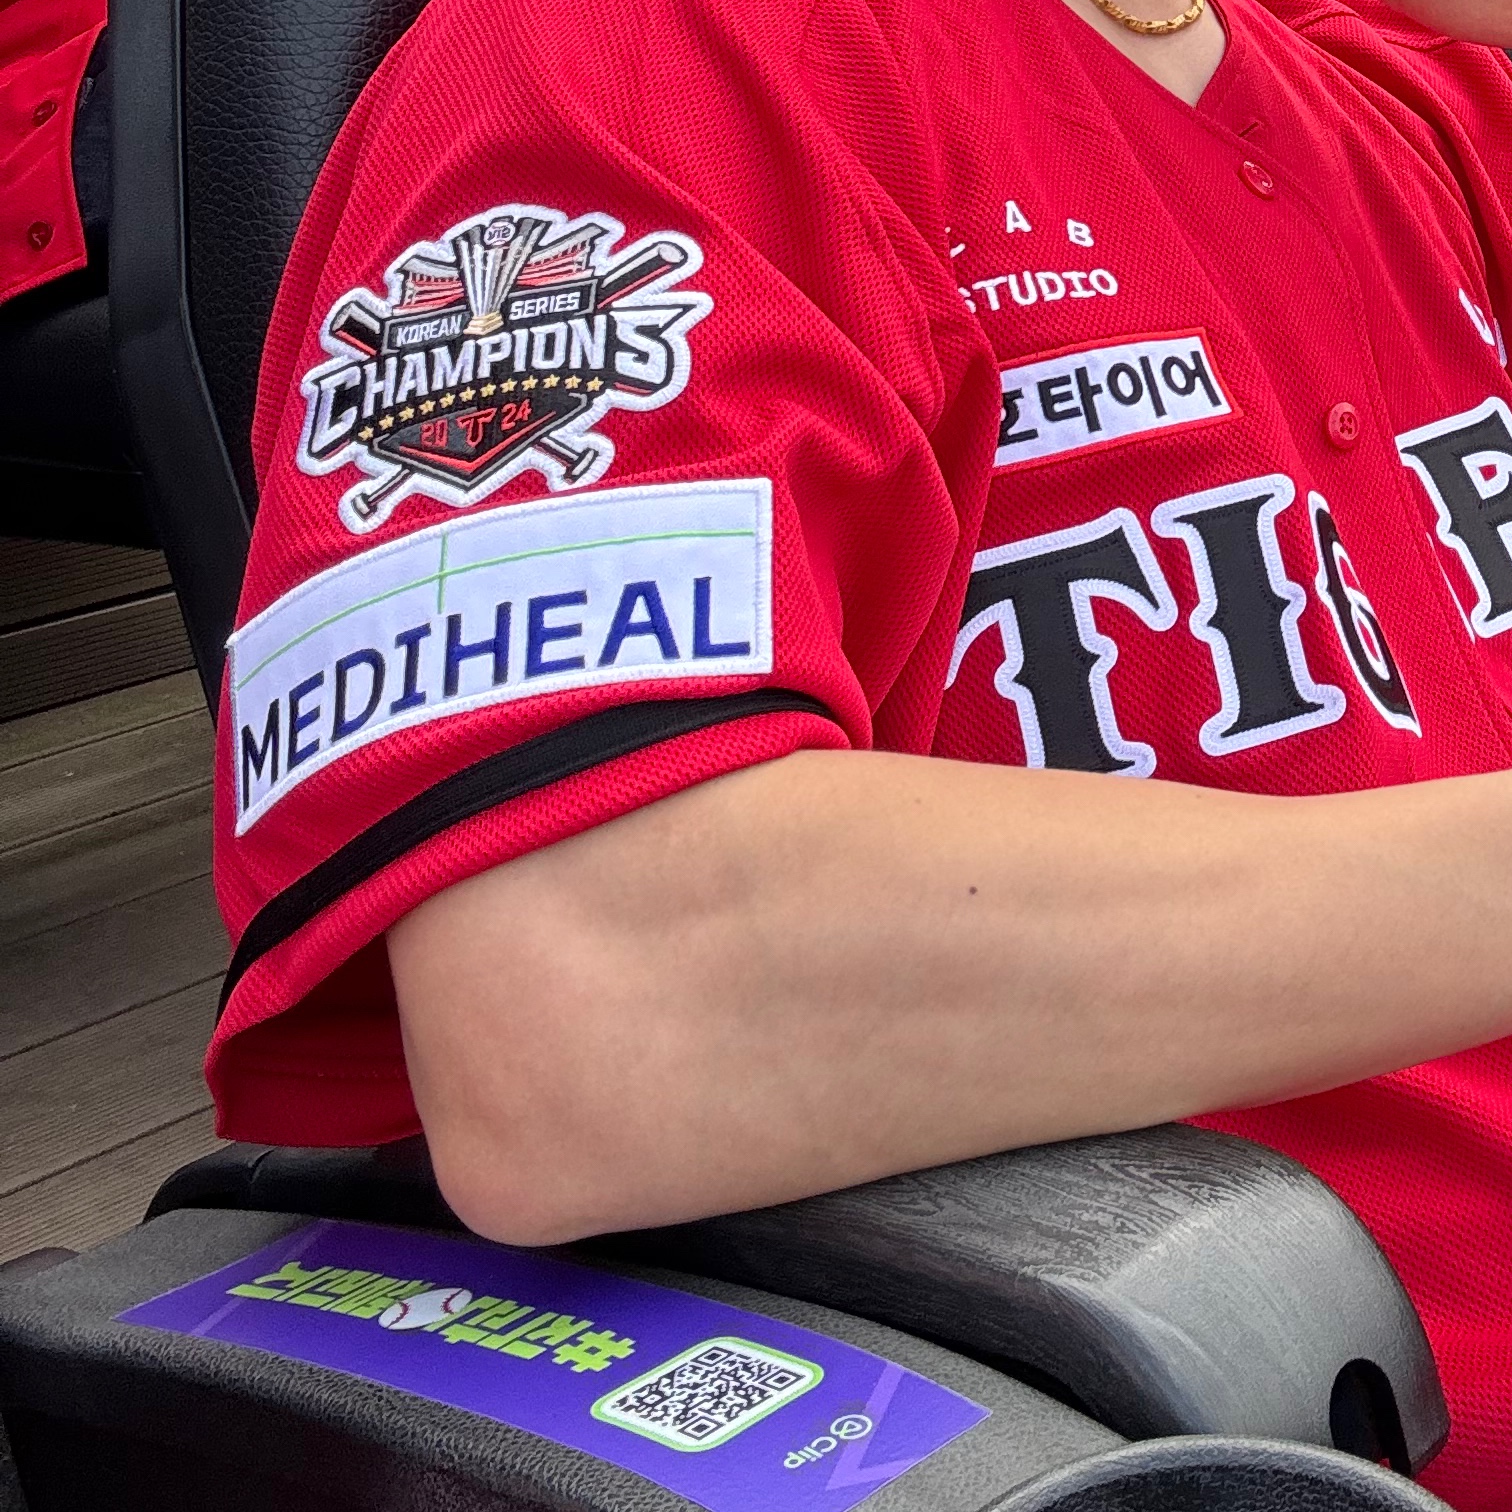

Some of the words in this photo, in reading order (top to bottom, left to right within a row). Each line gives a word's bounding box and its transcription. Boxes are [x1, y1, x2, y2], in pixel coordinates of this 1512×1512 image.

[396, 314, 462, 347] KOREAN
[509, 291, 581, 321] SERIES
[308, 305, 692, 455] CHAMPIONS
[501, 399, 532, 431] 24
[241, 575, 752, 810] MEDIHEAL
[783, 1436, 838, 1469] Clip
